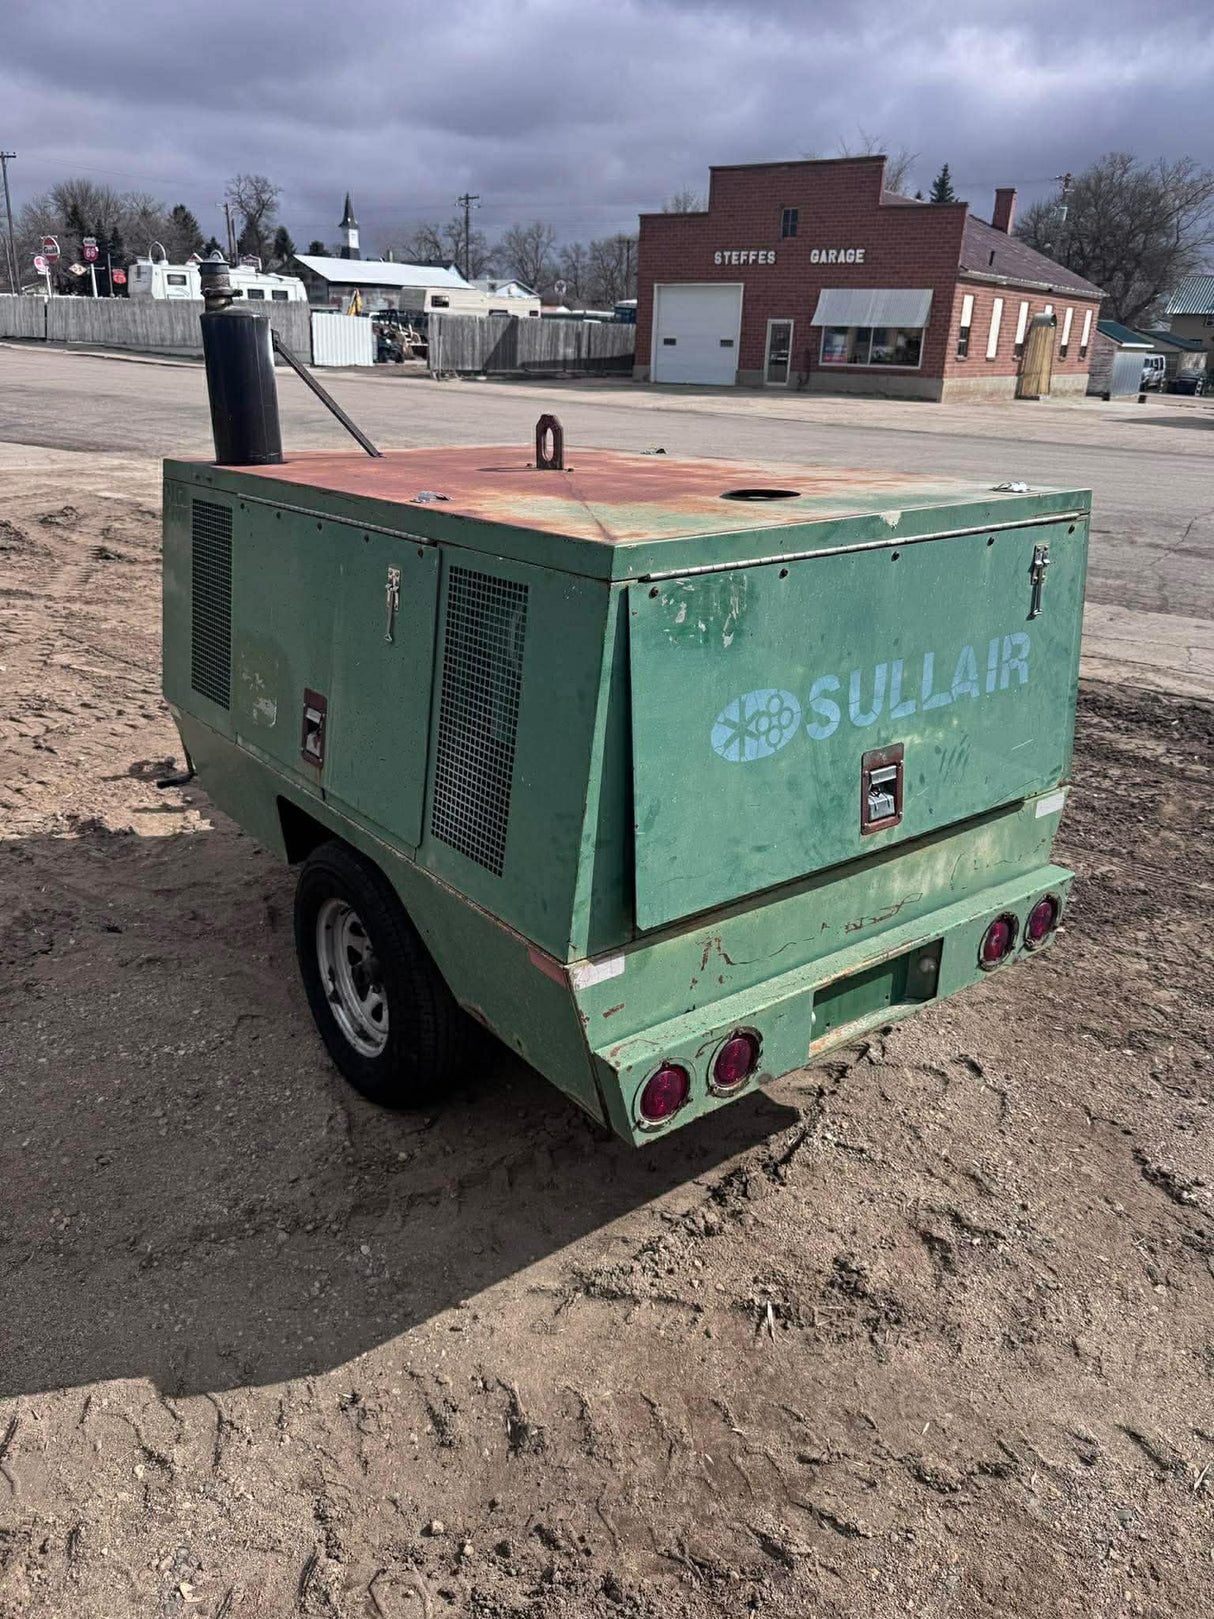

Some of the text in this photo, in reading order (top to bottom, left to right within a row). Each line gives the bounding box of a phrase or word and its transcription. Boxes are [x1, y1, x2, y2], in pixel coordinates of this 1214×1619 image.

[86, 248, 95, 257] 66
[714, 249, 865, 265] STEFFES GARAGE
[806, 632, 1030, 740] SULLAIR
